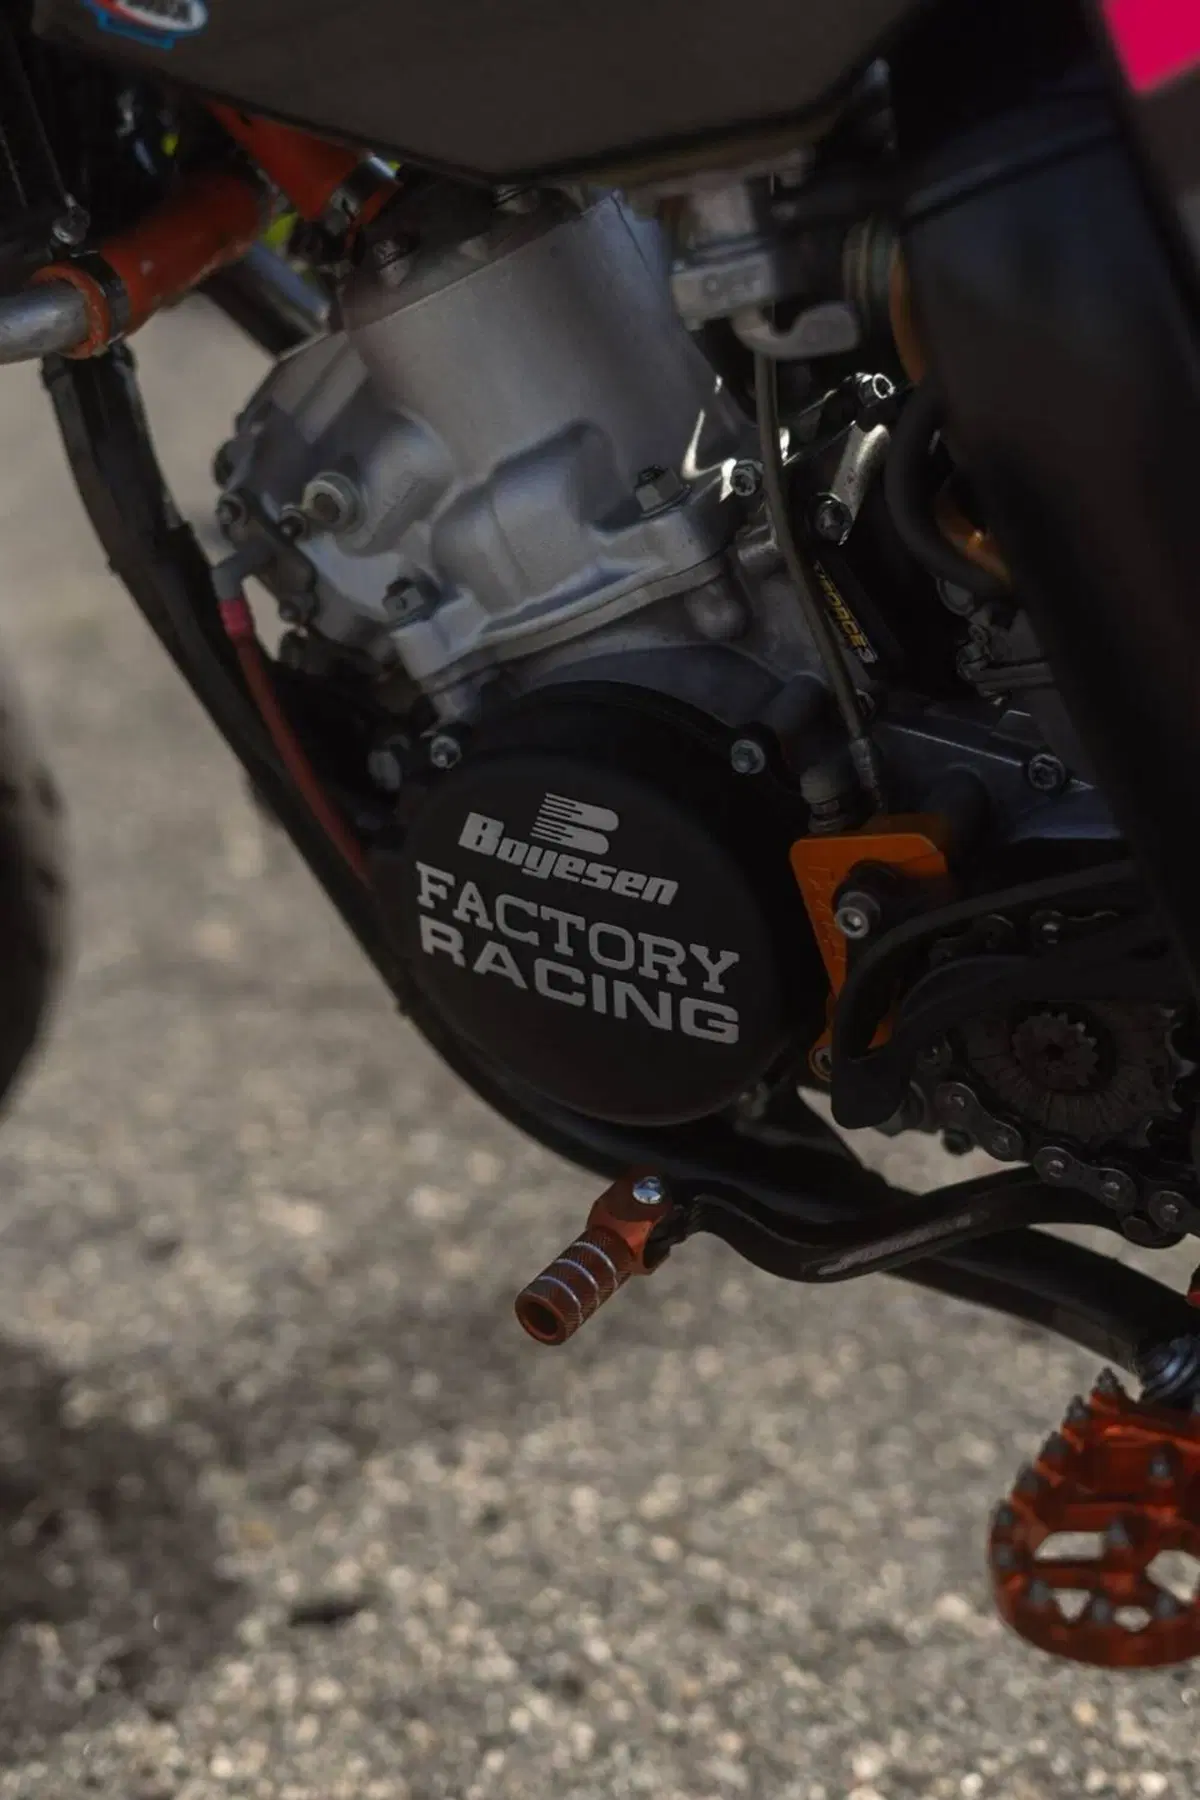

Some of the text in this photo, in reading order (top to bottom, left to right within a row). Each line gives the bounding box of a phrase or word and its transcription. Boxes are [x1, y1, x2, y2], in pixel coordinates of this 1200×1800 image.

[458, 812, 679, 906] Boyesen
[415, 860, 740, 994] FACTORY
[419, 914, 739, 1044] RACING
